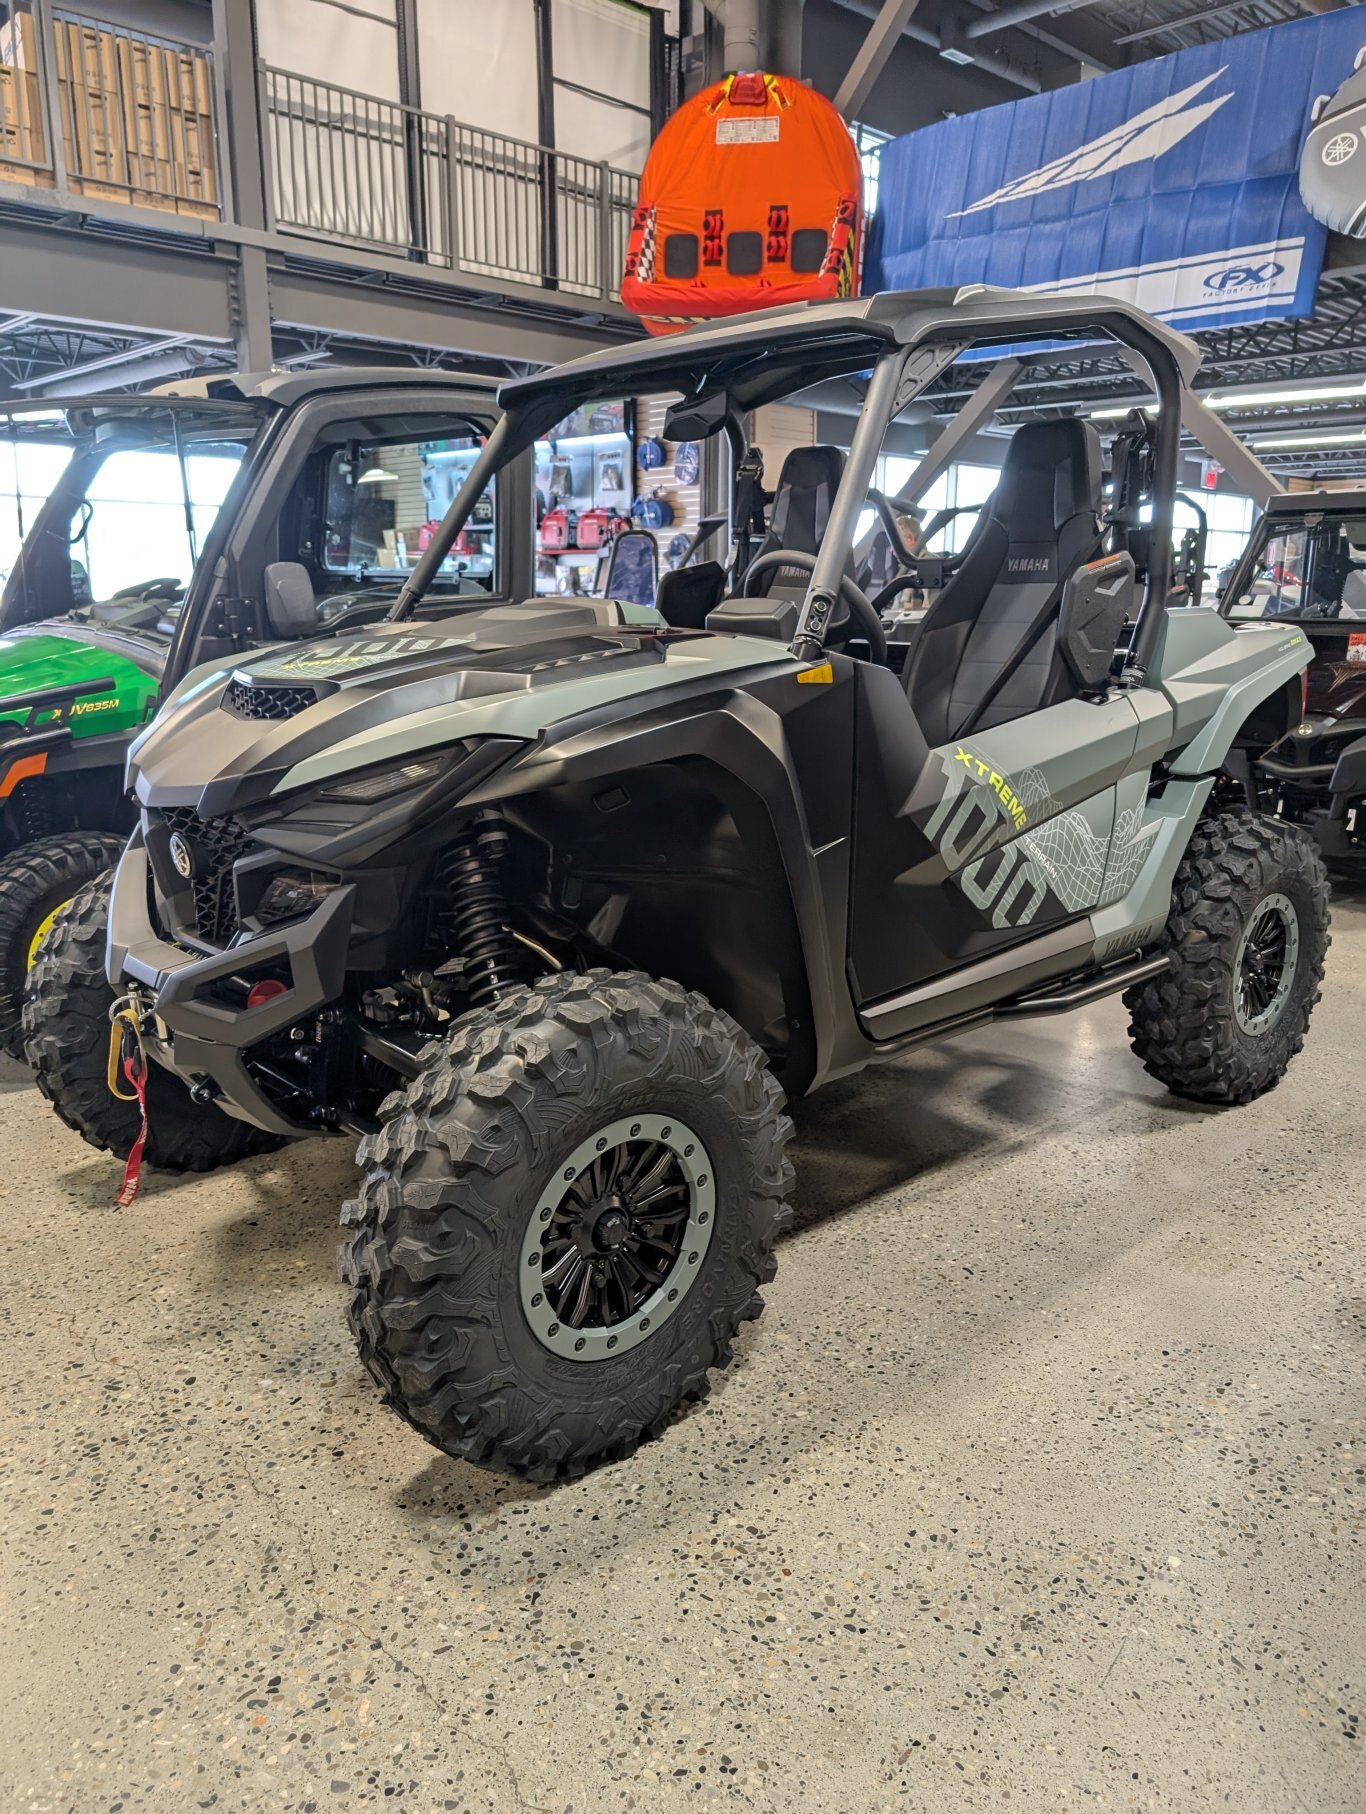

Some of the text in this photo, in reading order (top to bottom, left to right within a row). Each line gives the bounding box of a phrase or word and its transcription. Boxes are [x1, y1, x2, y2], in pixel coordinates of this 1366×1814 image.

[1216, 262, 1272, 290] FX
[1202, 286, 1244, 298] FACTORY
[779, 565, 811, 578] YAMAHA
[1007, 558, 1050, 572] YAMAHA
[954, 746, 1027, 830] XTREME
[923, 762, 1047, 930] 1000
[1024, 837, 1058, 879] TERRAIN
[1103, 925, 1153, 958] YAMAHA
